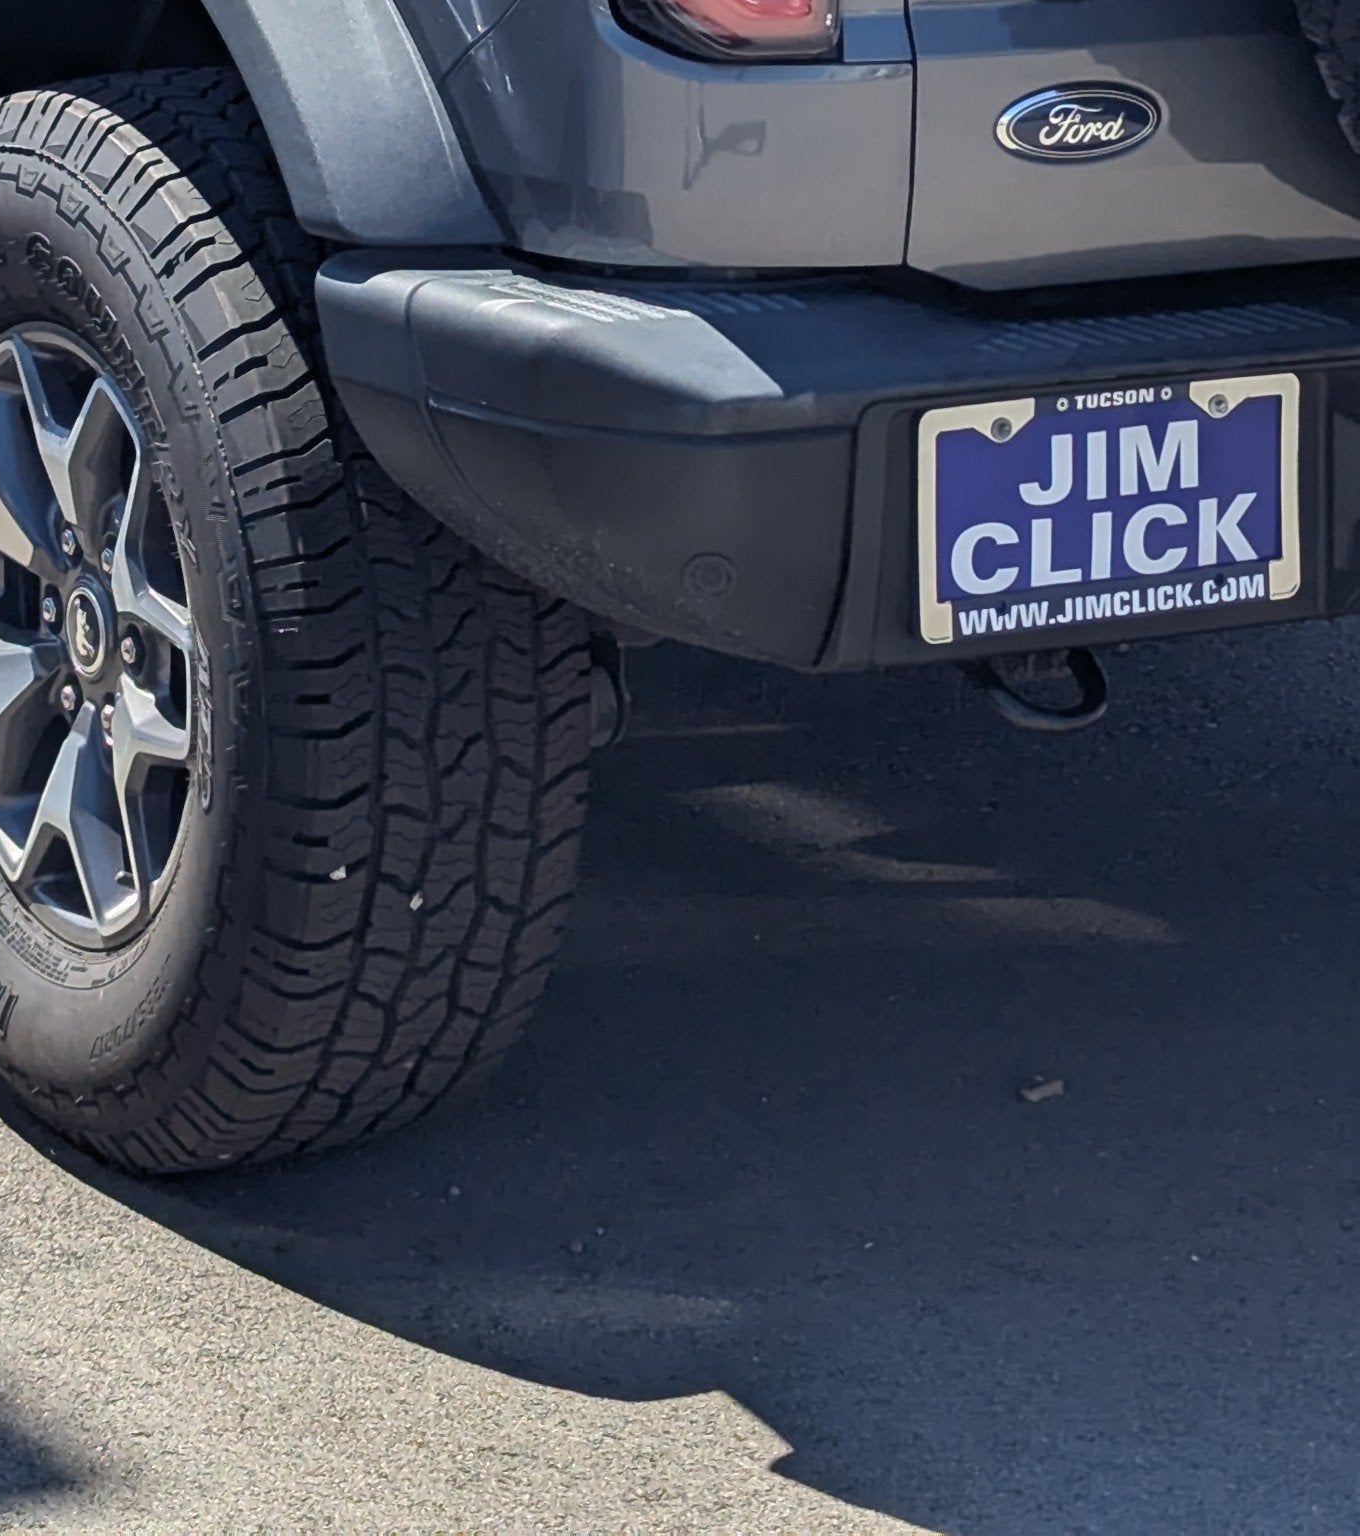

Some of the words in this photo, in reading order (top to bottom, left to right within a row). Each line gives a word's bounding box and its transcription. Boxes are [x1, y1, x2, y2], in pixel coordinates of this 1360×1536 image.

[1040, 104, 1125, 146] Ford
[1074, 386, 1155, 410] TUCSON
[1019, 420, 1199, 506] JIM
[951, 492, 1258, 595] CLICK
[958, 573, 1266, 636] WWW.JIMCLICK.COM
